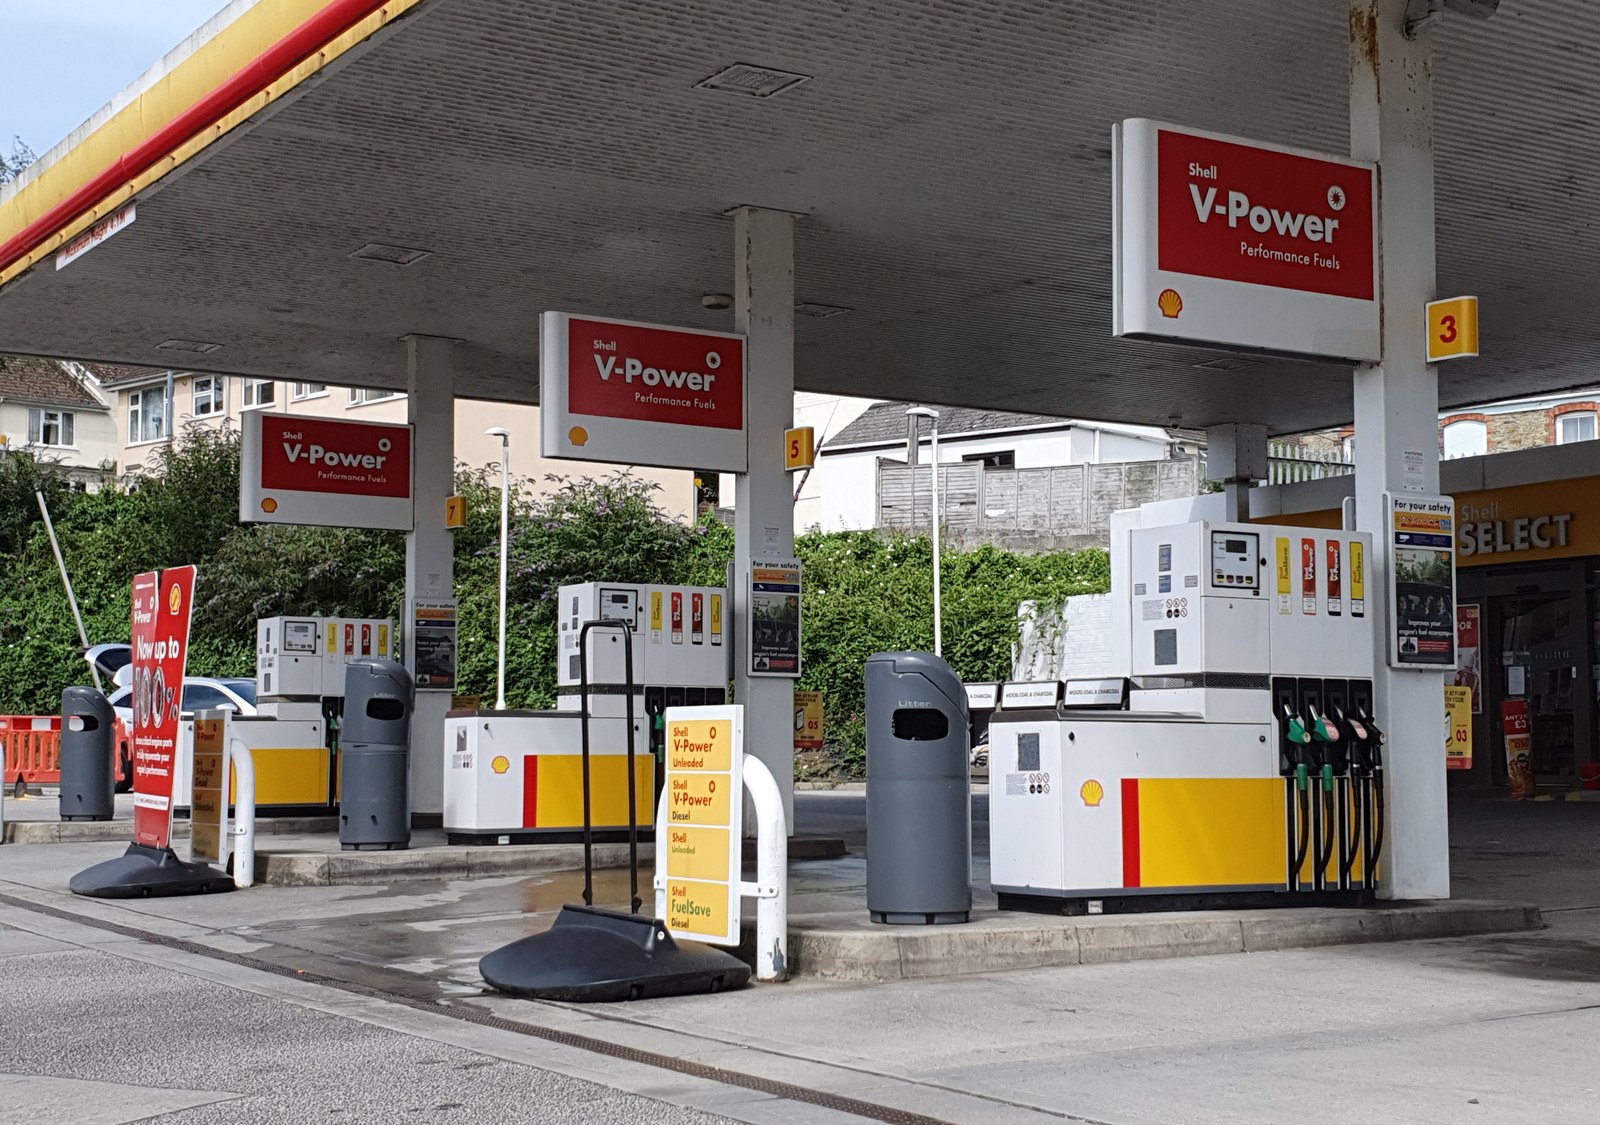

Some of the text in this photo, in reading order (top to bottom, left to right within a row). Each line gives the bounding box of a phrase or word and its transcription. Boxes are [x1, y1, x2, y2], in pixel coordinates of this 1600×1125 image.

[1189, 162, 1217, 180] Shell
[1189, 183, 1339, 243] V-Power
[1240, 242, 1340, 270] Performance Fuels
[1440, 315, 1456, 343] 3
[593, 340, 616, 351] Shell
[593, 354, 715, 392] V-Power
[636, 392, 716, 410] Performance Fuels
[283, 432, 302, 440] Shell
[283, 442, 386, 469] V-Power
[790, 440, 799, 458] 5
[318, 470, 386, 483] Performance Fuels
[450, 505, 455, 520] 7
[1394, 500, 1450, 514] For your safety
[1461, 502, 1498, 520] Shell
[1458, 514, 1570, 556] SELECT
[136, 635, 179, 664] Now up to
[674, 727, 688, 737] Shell
[808, 721, 818, 730] 05
[1456, 730, 1467, 742] 03
[674, 739, 713, 752] V-Power
[673, 758, 704, 768] Unleaded
[673, 780, 687, 790] Shell
[673, 792, 712, 806] V-Power
[672, 810, 690, 821] Diesel
[672, 833, 686, 843] Shell
[672, 845, 696, 854] Unleaded
[672, 886, 686, 897] Shell
[672, 899, 711, 917] FuelSave
[671, 918, 689, 929] Diesel
